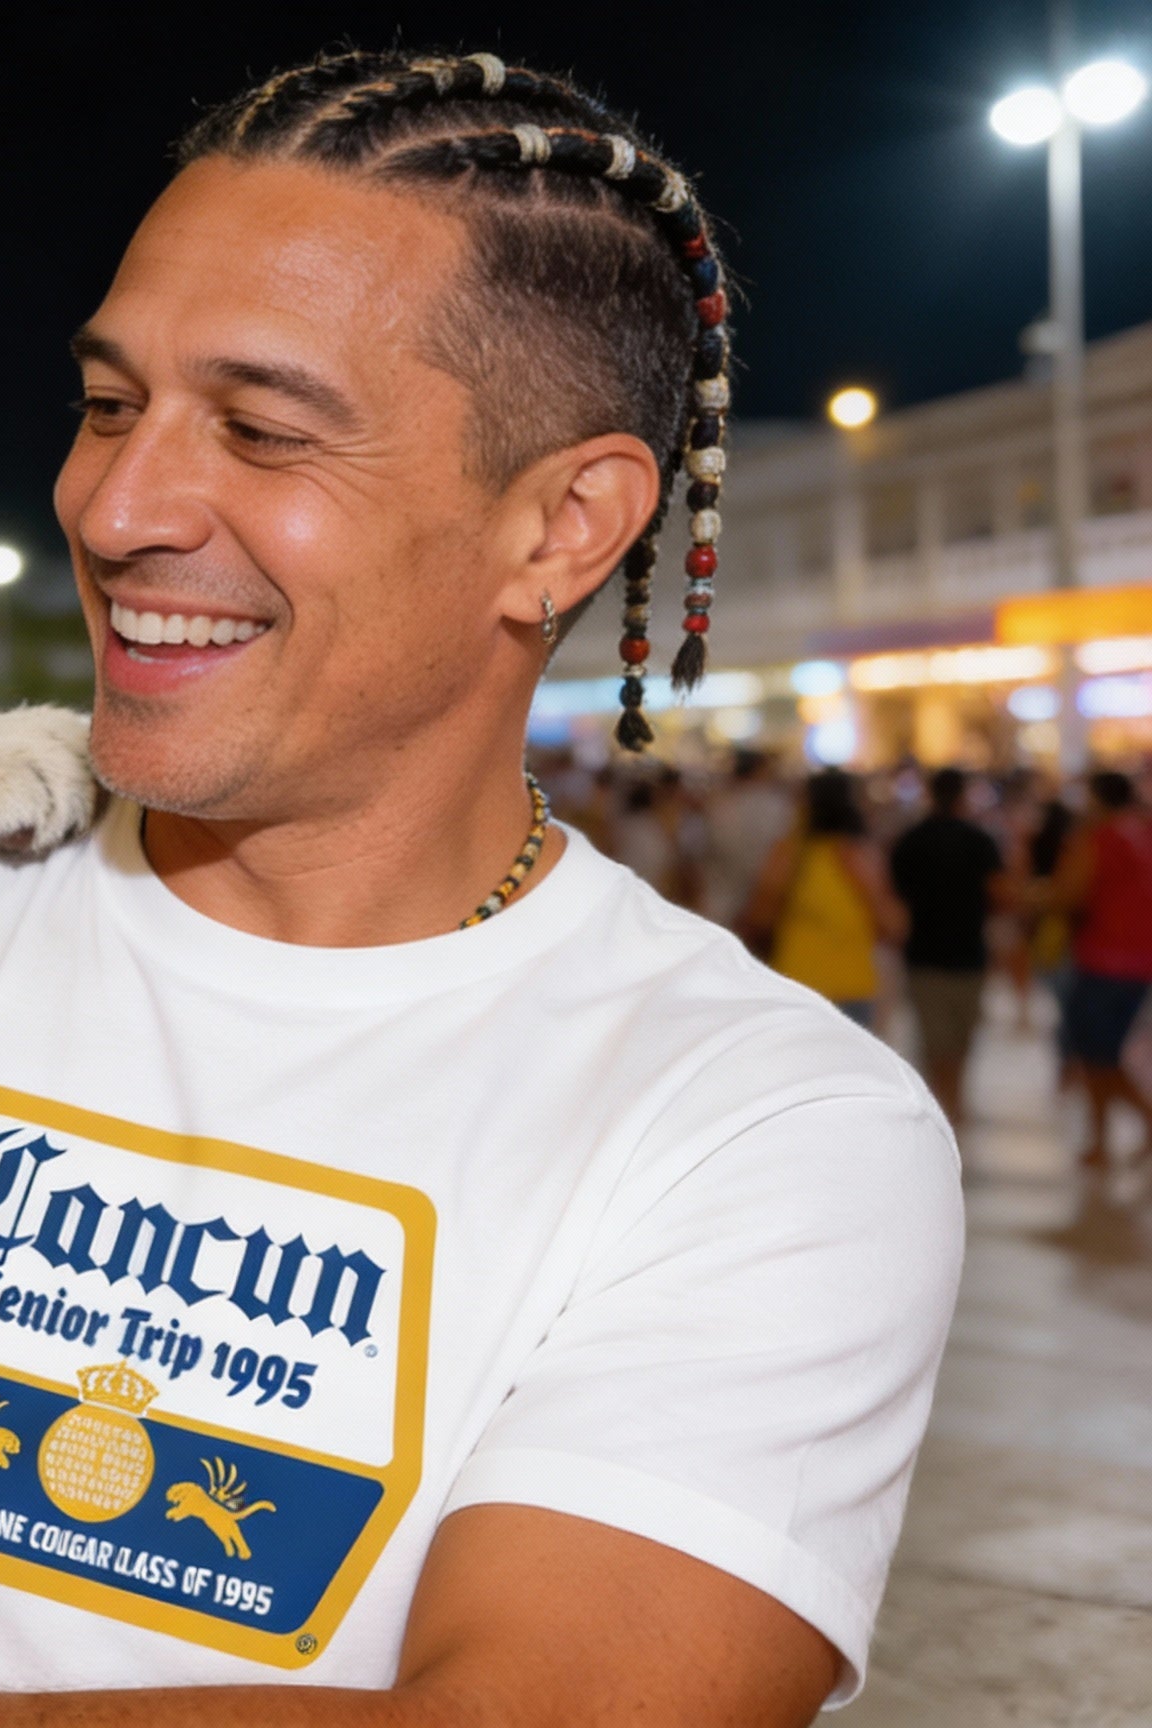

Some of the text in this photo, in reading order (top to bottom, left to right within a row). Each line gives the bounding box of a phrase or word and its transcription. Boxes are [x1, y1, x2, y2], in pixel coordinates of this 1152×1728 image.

[117, 1307, 203, 1380] Trip
[210, 1342, 318, 1409] 1995
[181, 1565, 213, 1596] OF
[213, 1573, 275, 1615] 1995
